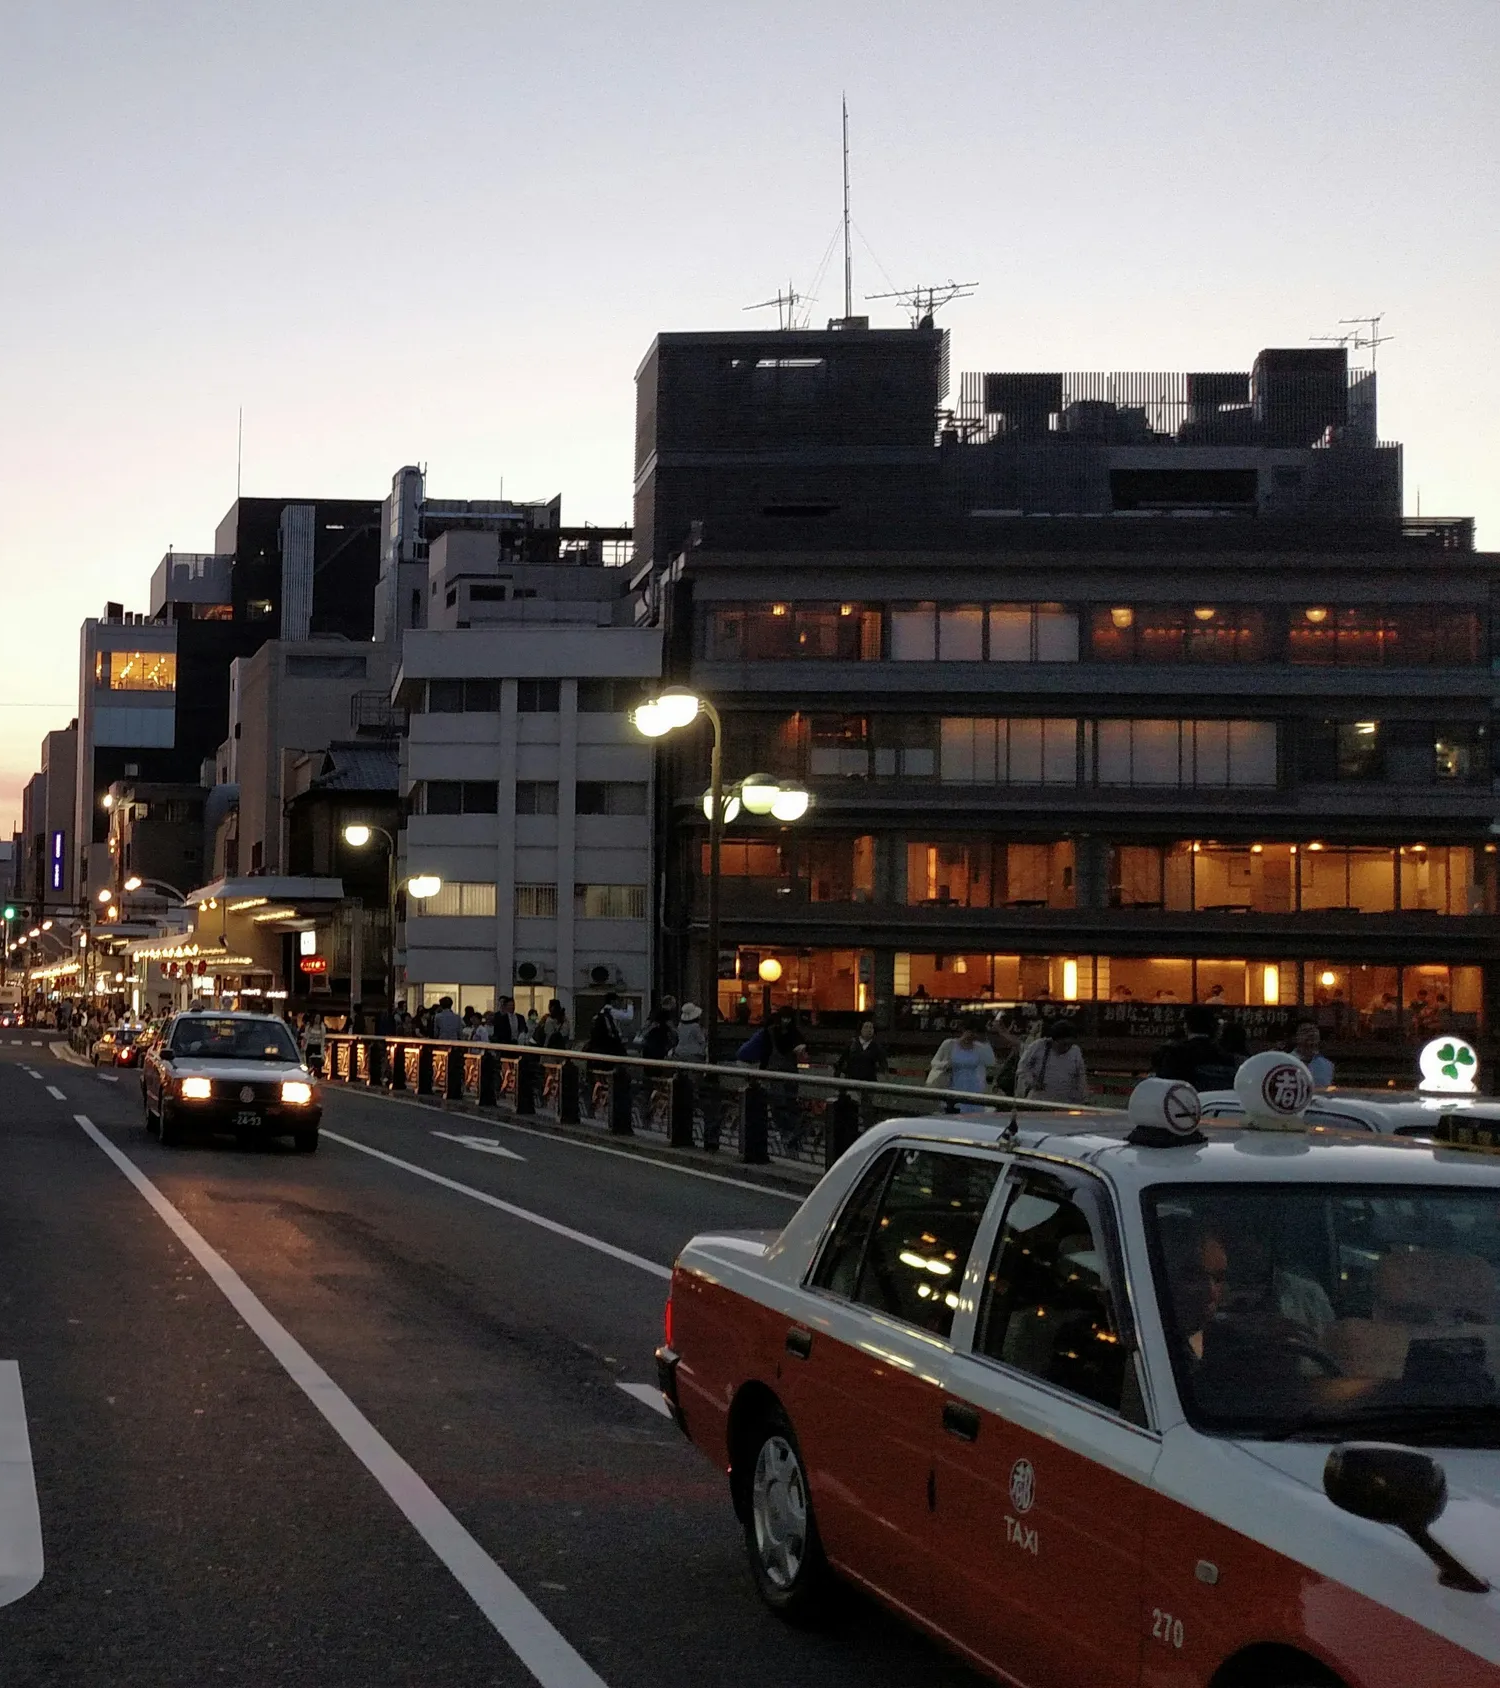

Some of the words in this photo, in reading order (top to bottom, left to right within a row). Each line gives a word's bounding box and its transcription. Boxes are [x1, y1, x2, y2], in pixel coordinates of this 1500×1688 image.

[1271, 1067, 1311, 1113] 都
[1004, 1515, 1038, 1556] TAXI
[1152, 1607, 1184, 1649] 270
